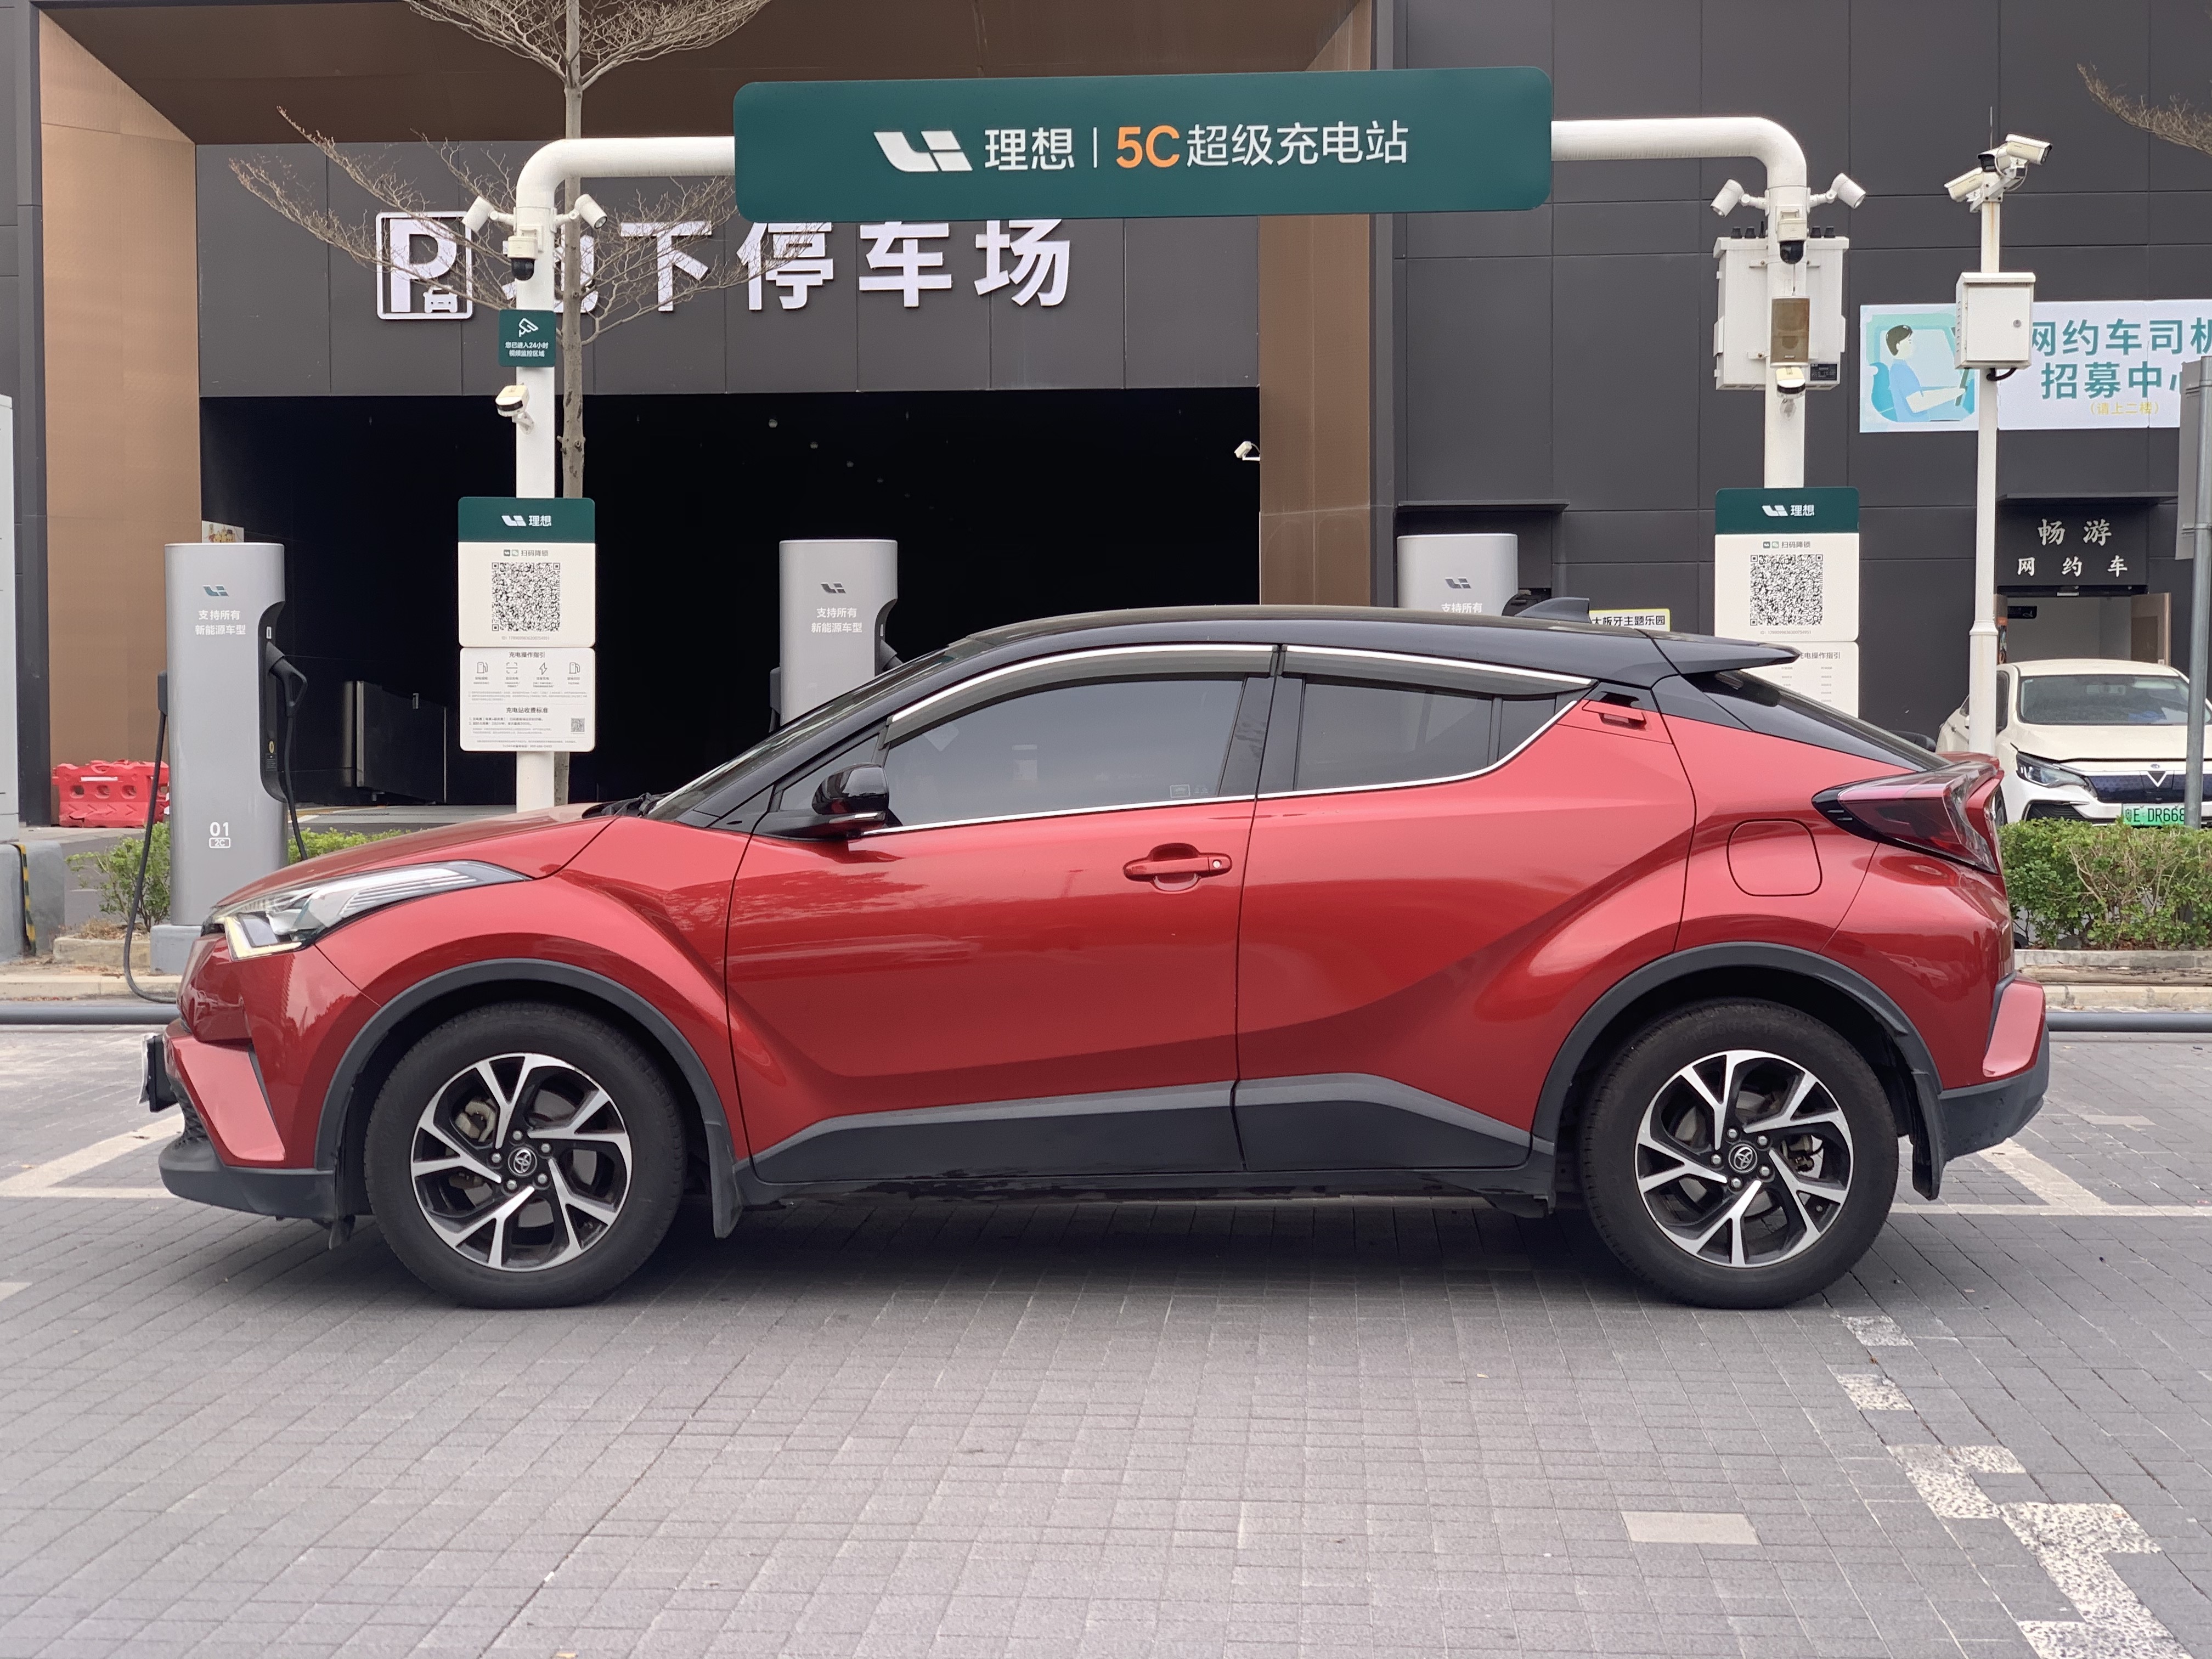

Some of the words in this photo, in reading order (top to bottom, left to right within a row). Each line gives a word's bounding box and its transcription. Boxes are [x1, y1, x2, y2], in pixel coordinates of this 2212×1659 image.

[984, 126, 1075, 171] 理想
[1790, 504, 1815, 516] 理想
[528, 515, 552, 527] 理想
[2038, 518, 2112, 546] 畅游
[1781, 540, 1811, 549] 扫码降锁
[2017, 555, 2128, 578] 网约车
[816, 607, 857, 618] 支持所有
[1441, 602, 1483, 613] 支持所有
[198, 610, 240, 621] 支持所有
[195, 624, 246, 636] 新能源车型
[811, 622, 863, 634] 新能源车型
[210, 821, 229, 837] 01
